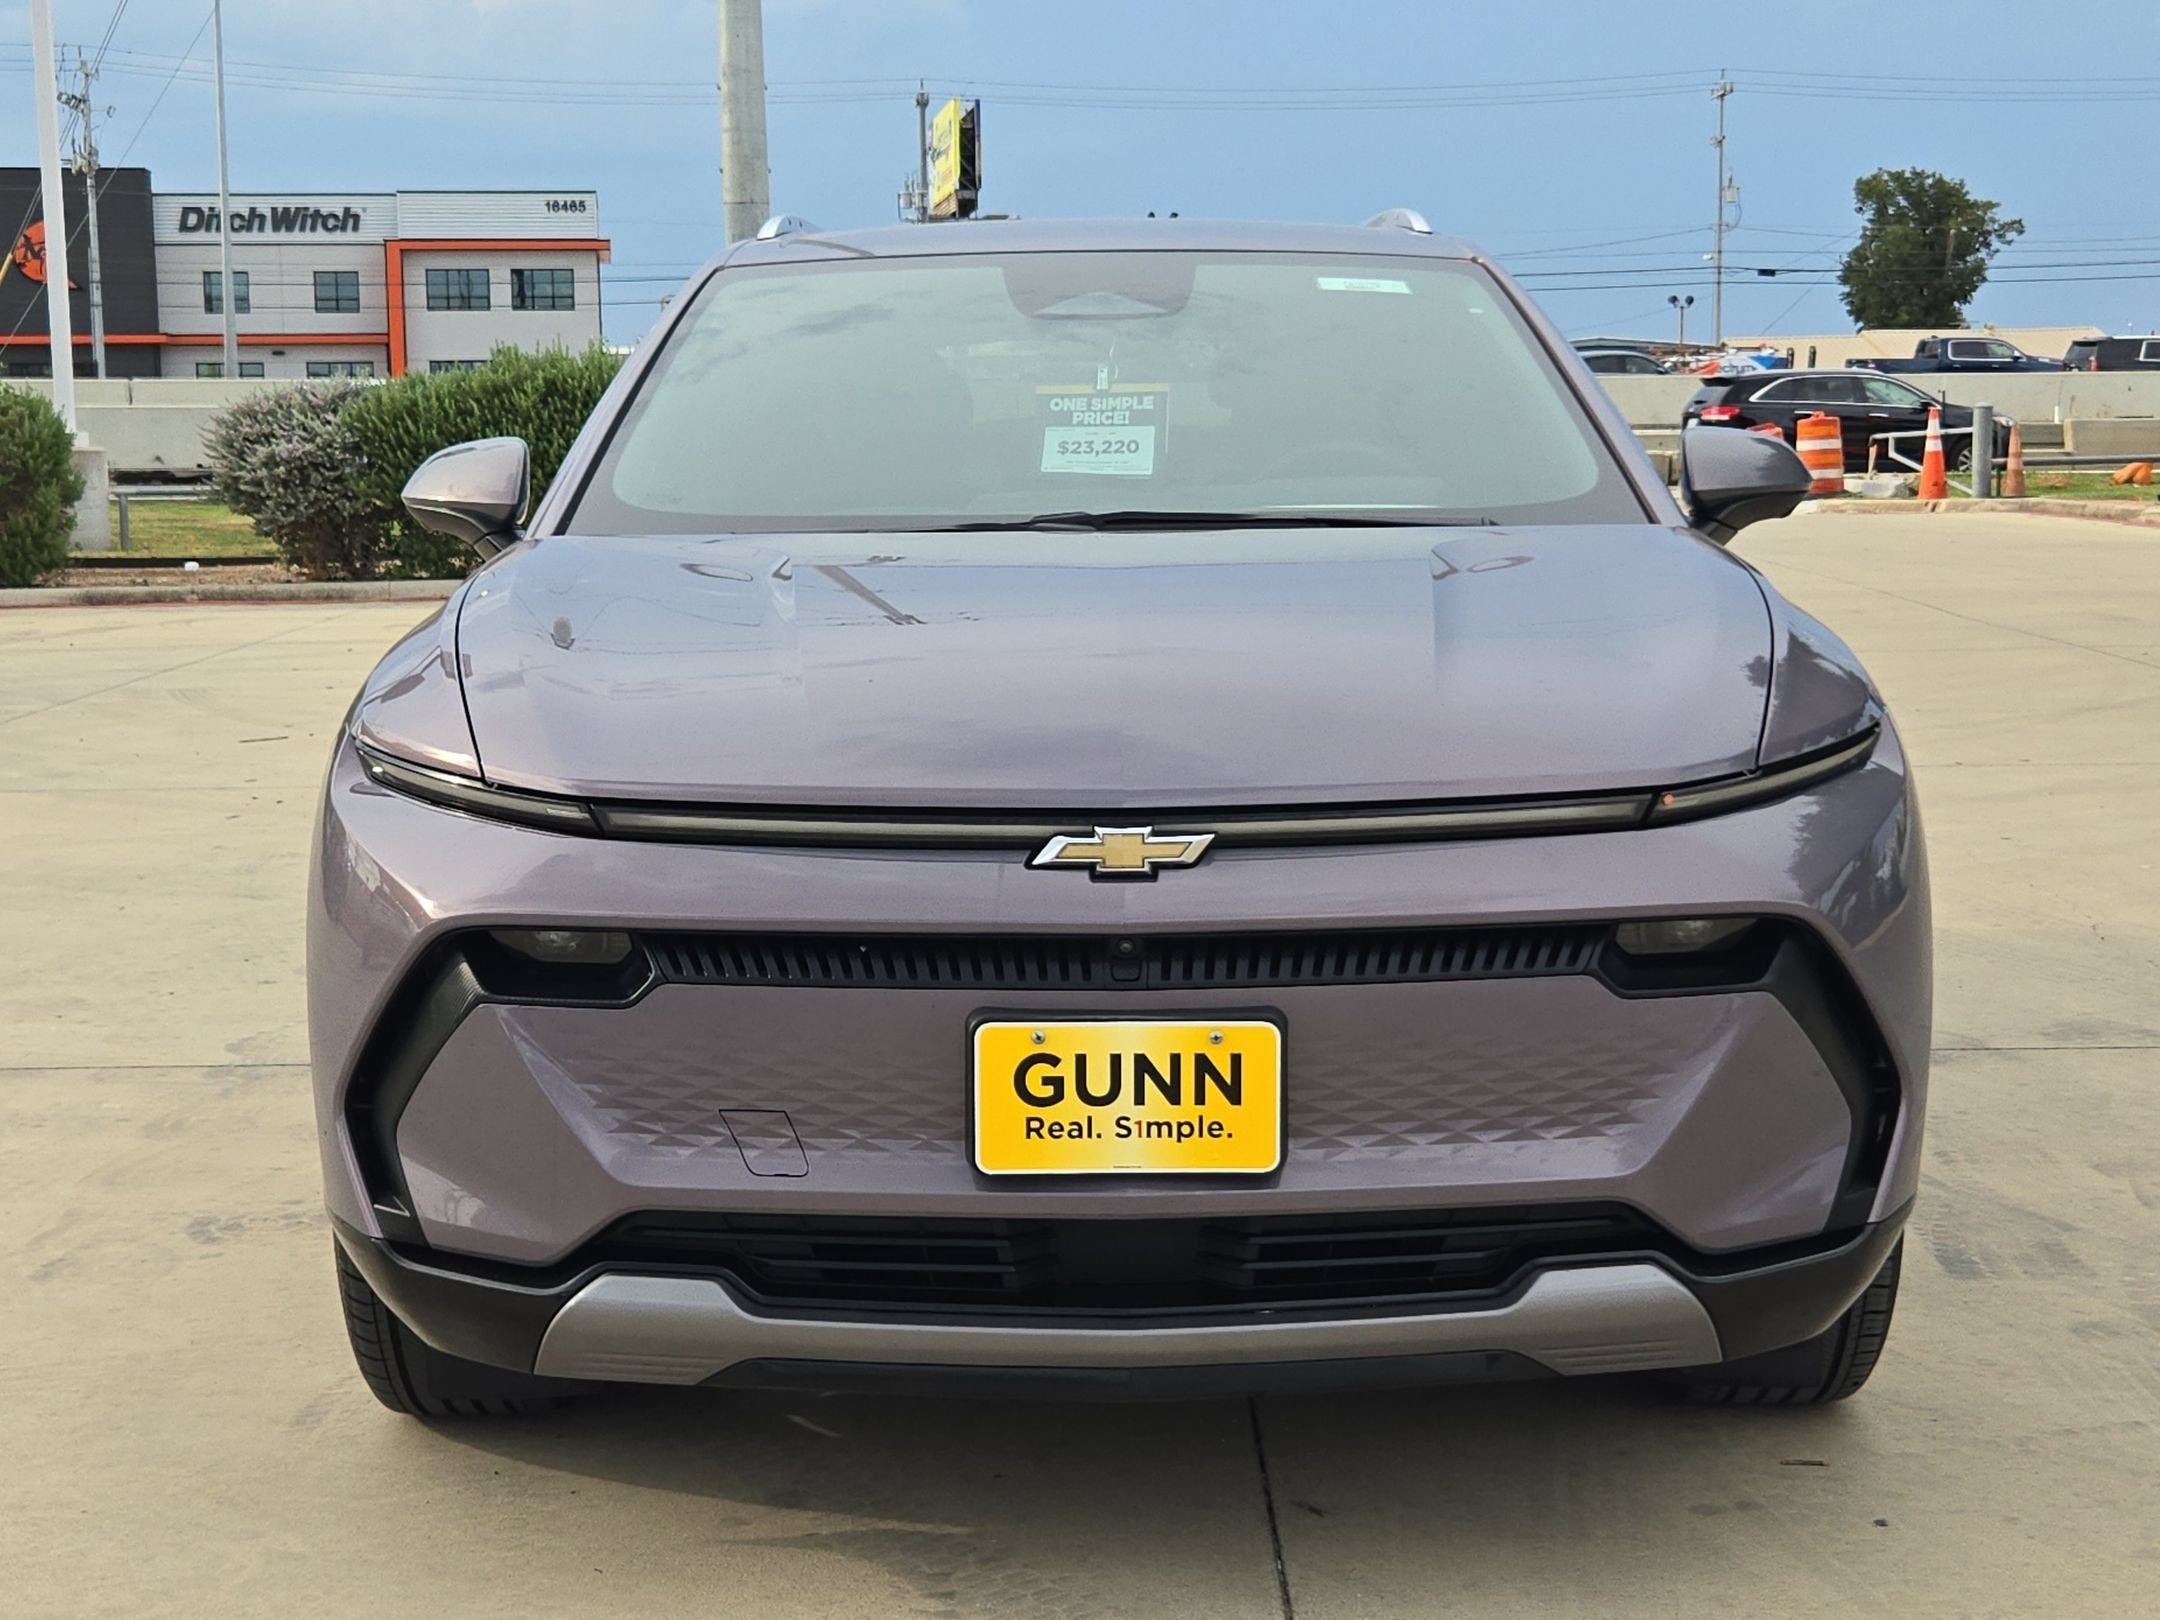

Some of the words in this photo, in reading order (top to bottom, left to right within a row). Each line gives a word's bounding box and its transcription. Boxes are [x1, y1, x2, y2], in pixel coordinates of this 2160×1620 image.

[271, 206, 361, 233] Witch
[1050, 397, 1087, 412] ONE
[1091, 395, 1154, 411] SIMPLE
[1072, 411, 1130, 425] PRICE!
[1057, 439, 1140, 457] $23,220
[1013, 1052, 1242, 1108] GUNN
[1025, 1115, 1102, 1139] Real.
